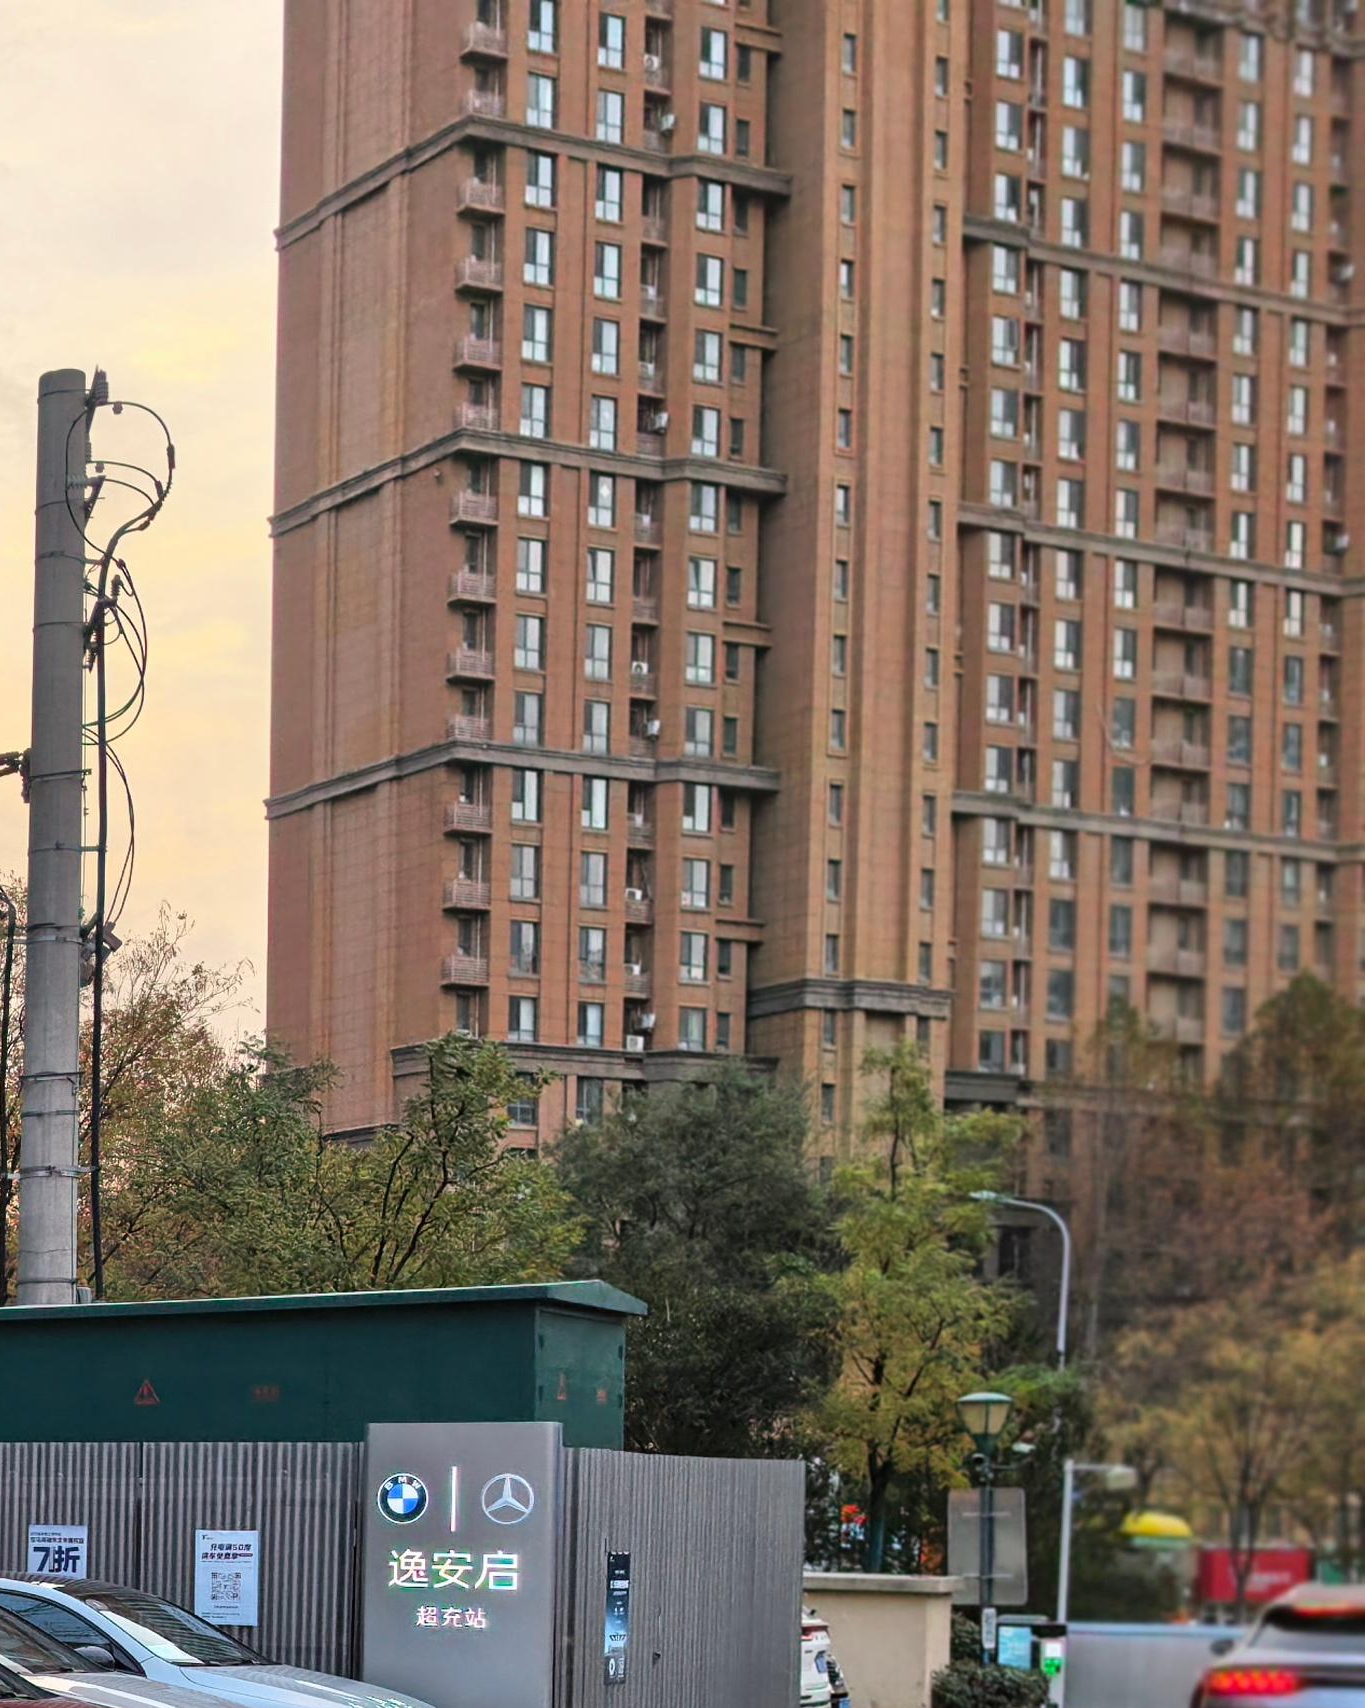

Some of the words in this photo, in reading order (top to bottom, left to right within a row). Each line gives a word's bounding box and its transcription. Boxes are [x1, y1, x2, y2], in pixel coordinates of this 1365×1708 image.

[384, 1476, 422, 1490] BMW
[33, 1546, 80, 1573] 7折
[388, 1548, 520, 1591] 逸安启
[416, 1605, 487, 1629] 超充站
